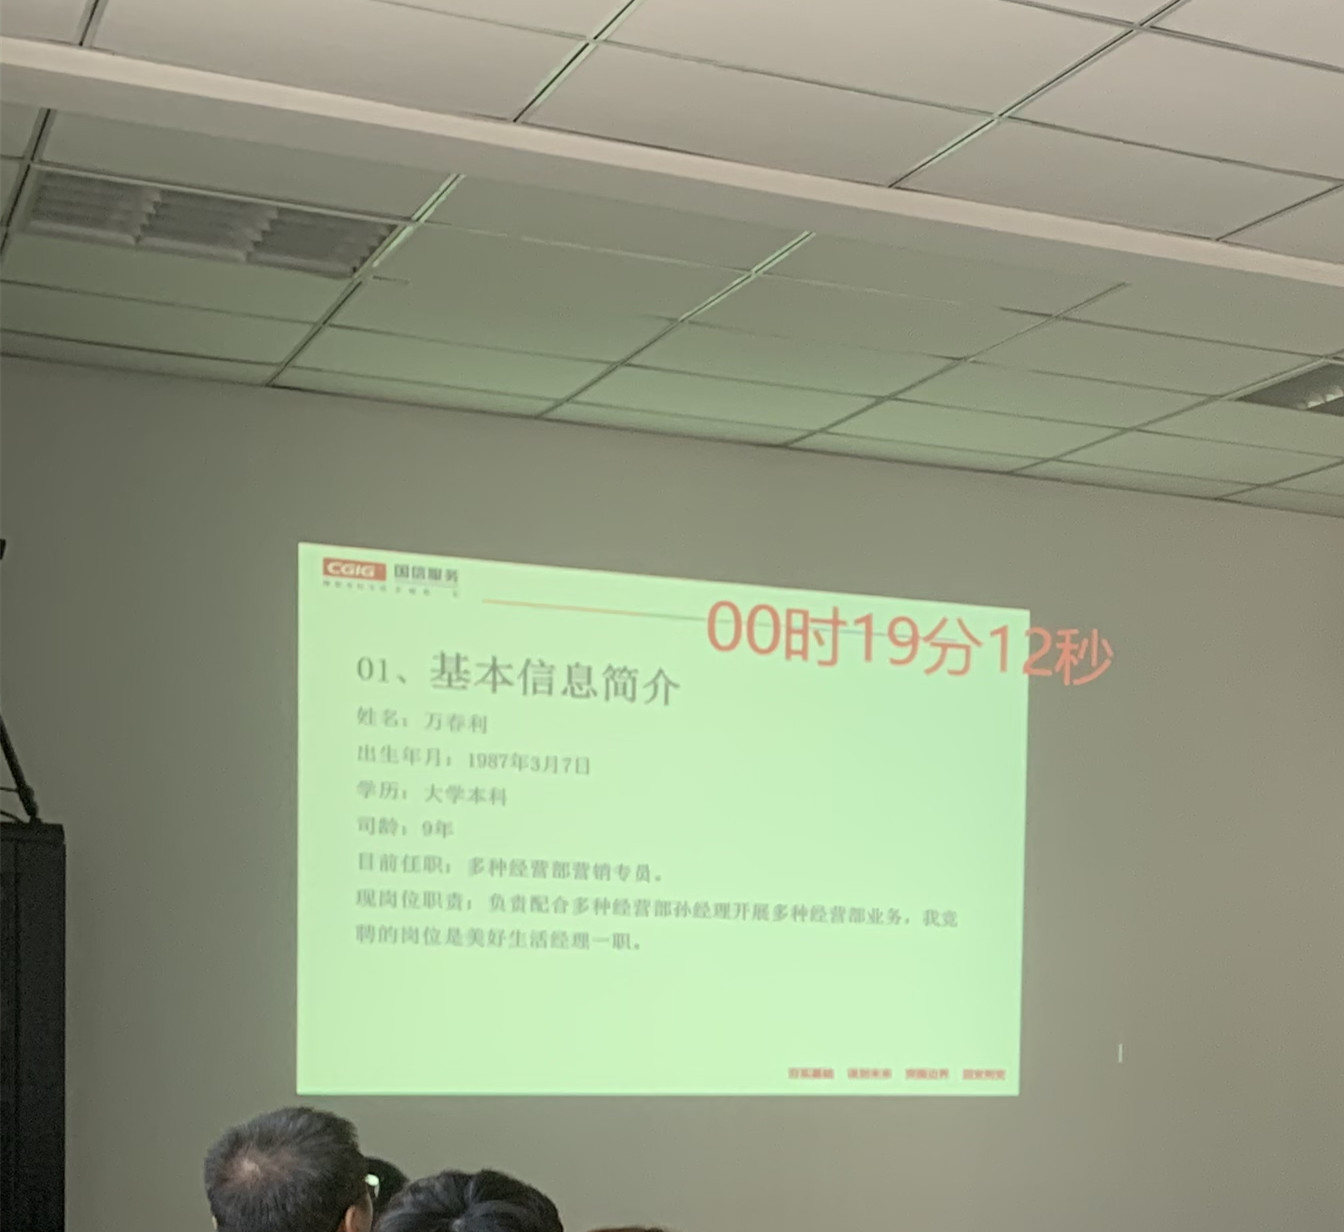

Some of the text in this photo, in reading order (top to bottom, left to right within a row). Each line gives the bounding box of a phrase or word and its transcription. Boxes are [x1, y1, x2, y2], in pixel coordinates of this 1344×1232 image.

[327, 561, 376, 578] CGIG
[394, 563, 459, 583] 国信服务
[706, 600, 1114, 686] 00时19分12秒
[356, 650, 681, 706] 01、基本信息简介
